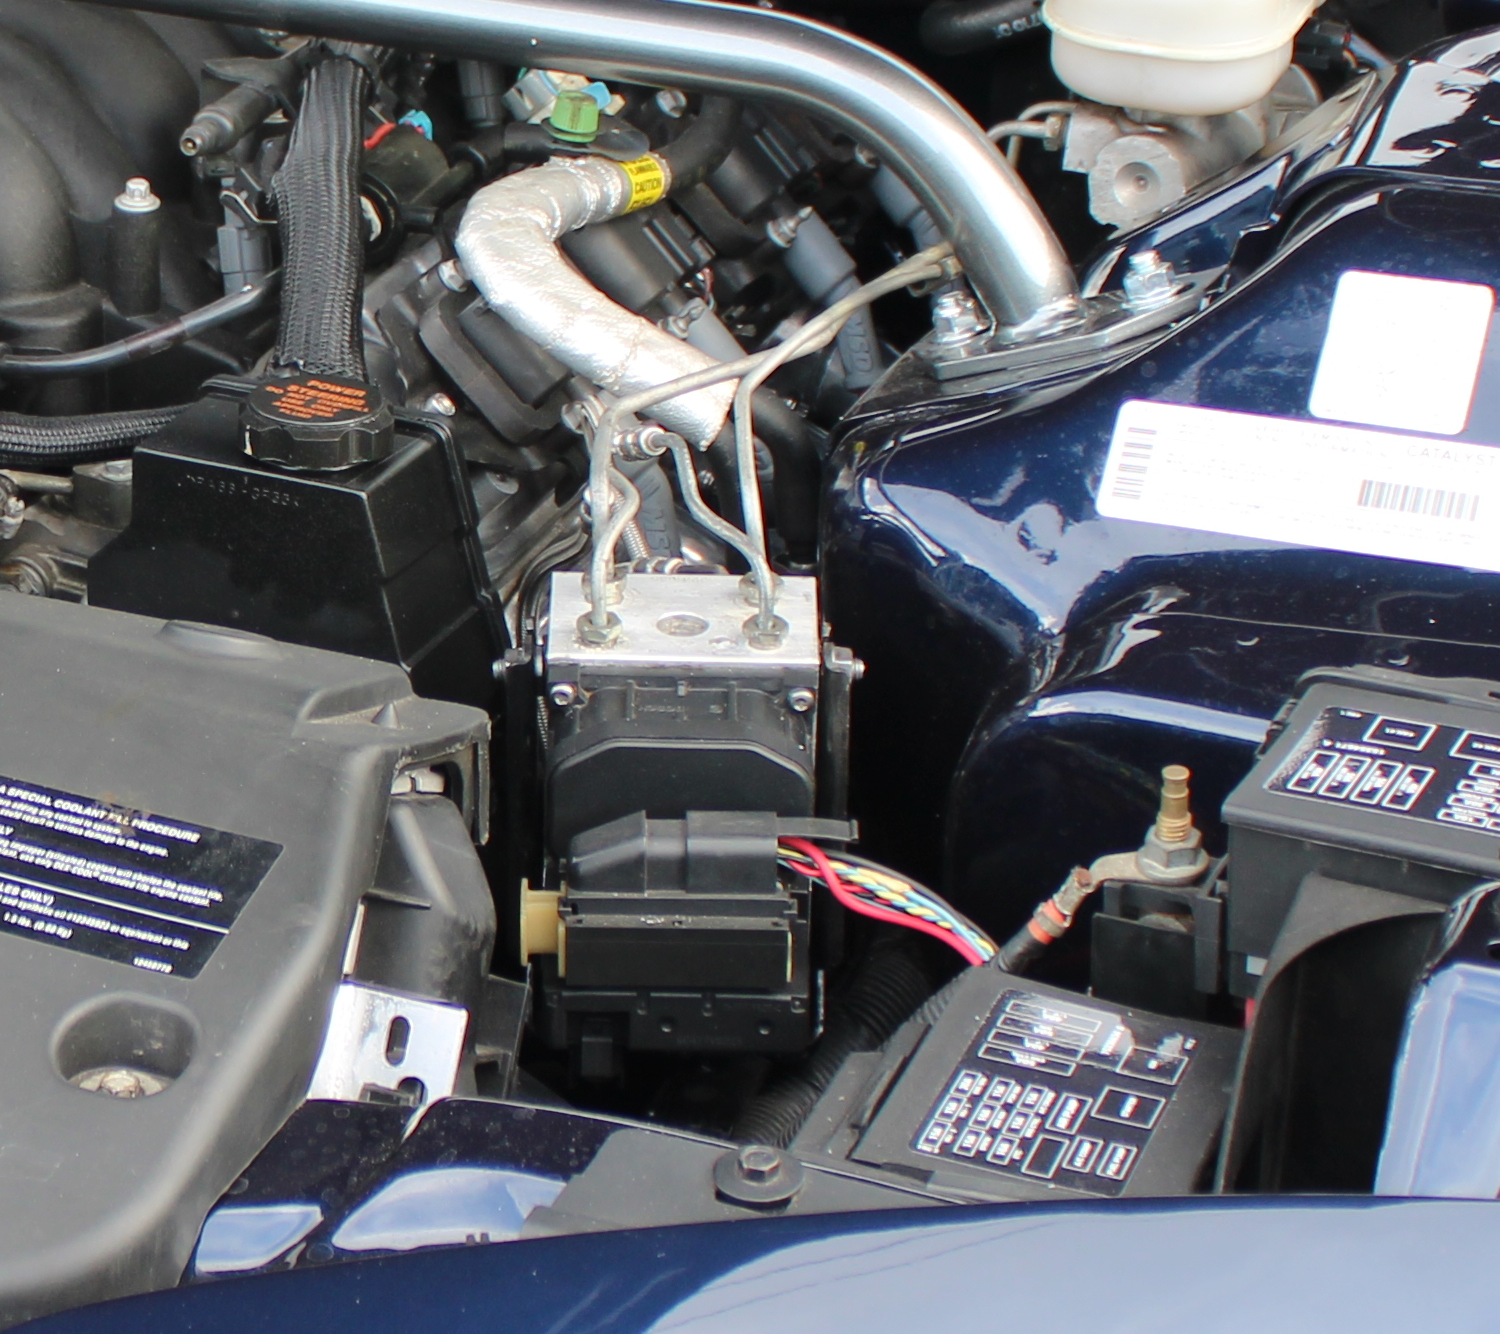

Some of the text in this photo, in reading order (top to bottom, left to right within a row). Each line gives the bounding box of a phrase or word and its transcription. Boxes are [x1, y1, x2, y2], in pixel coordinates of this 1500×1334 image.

[286, 384, 366, 406] STEERING
[306, 379, 367, 398] POWER
[1405, 443, 1497, 467] CATALYST
[7, 787, 51, 806] SPECIAL
[54, 799, 107, 819] COOLANT
[107, 812, 129, 825] FILL
[131, 818, 200, 842] PROCEDURE
[53, 813, 84, 825] coolant
[83, 819, 92, 828] to
[20, 889, 54, 905] ONLY)
